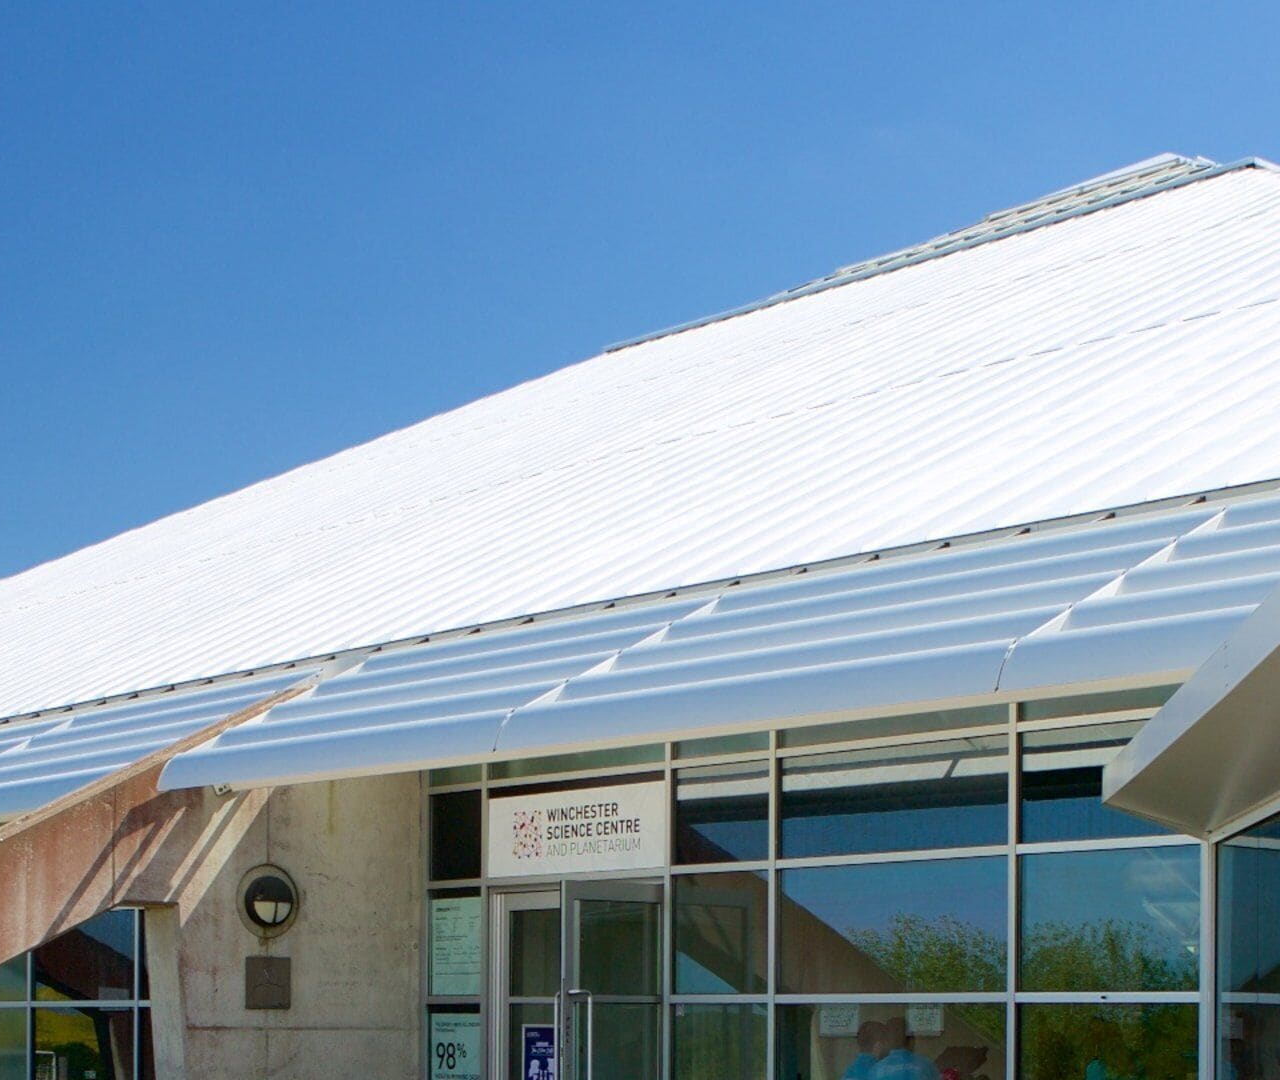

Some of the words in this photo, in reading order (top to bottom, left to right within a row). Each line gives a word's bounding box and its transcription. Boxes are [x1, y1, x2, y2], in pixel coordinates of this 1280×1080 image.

[546, 802, 619, 822] WINCHESTER
[546, 822, 593, 840] SCIENCE
[595, 818, 641, 837] CENTRE
[546, 842, 567, 857] AND
[570, 837, 641, 856] PLANETARIUM
[436, 1042, 467, 1070] 98%
